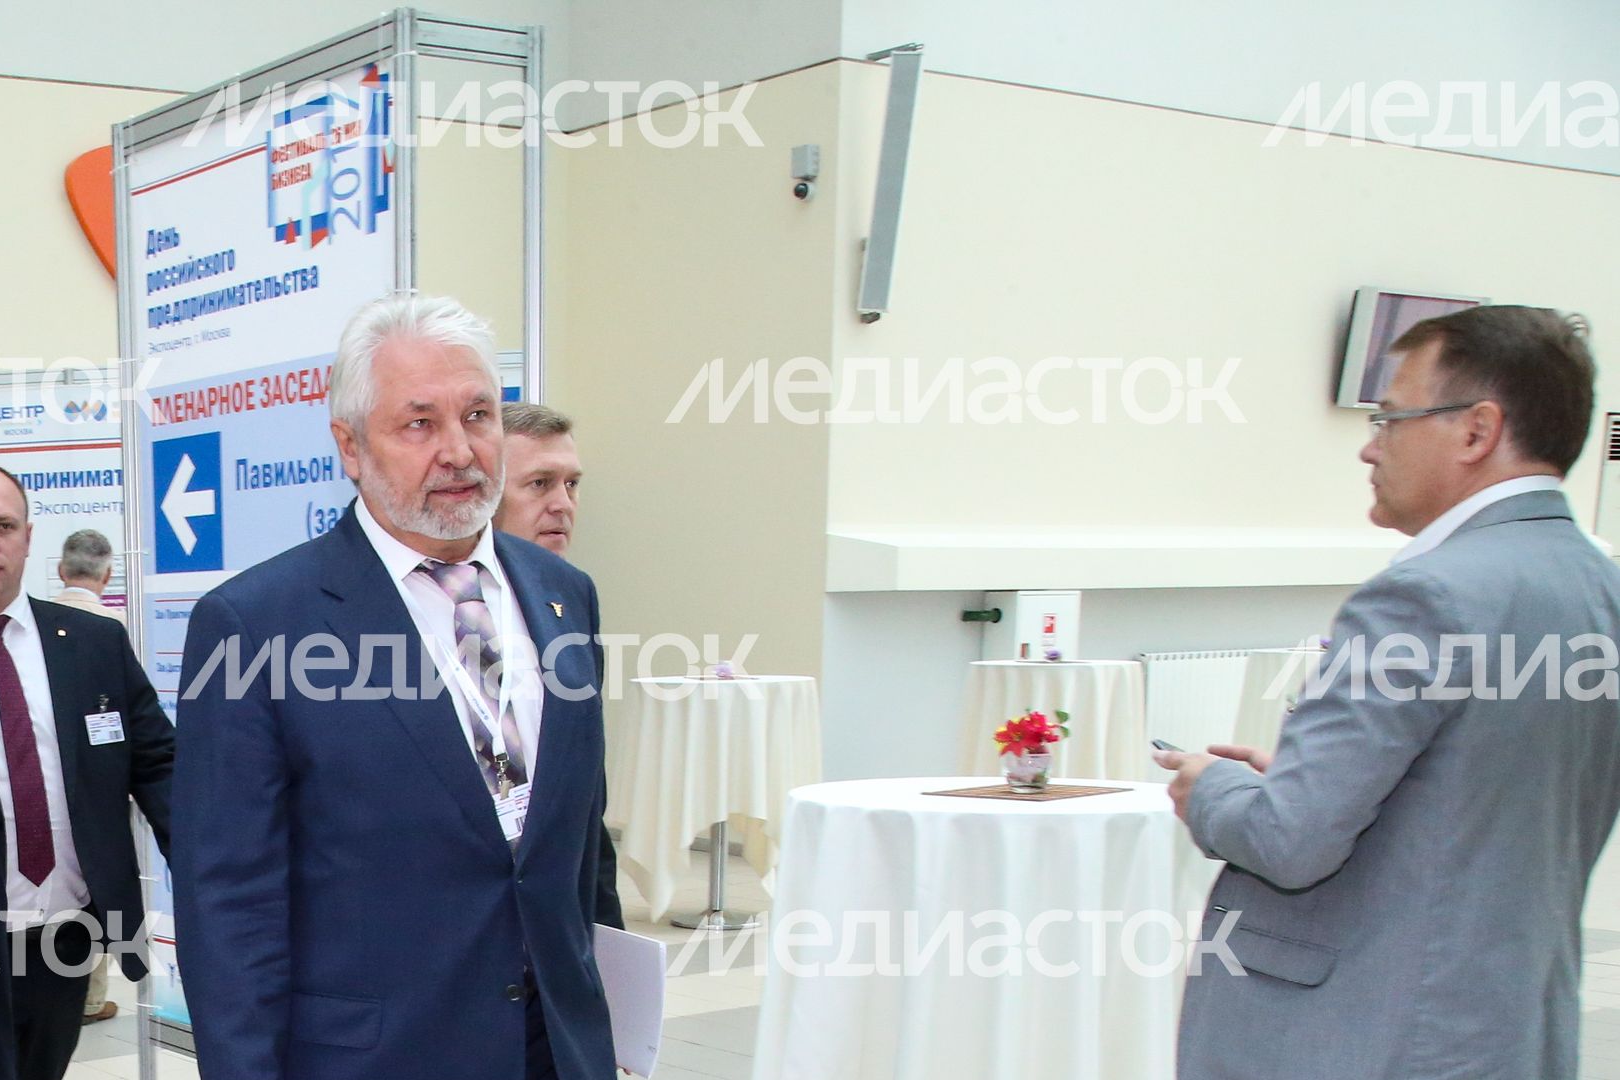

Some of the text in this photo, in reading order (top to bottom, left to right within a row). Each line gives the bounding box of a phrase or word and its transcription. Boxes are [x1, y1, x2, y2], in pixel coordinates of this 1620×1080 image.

[147, 227, 180, 260] День
[147, 249, 236, 296] российского
[148, 265, 319, 329] предпринимательства
[152, 379, 255, 427] ПЛЕНАРНОЕ
[235, 456, 333, 491] Павильон
